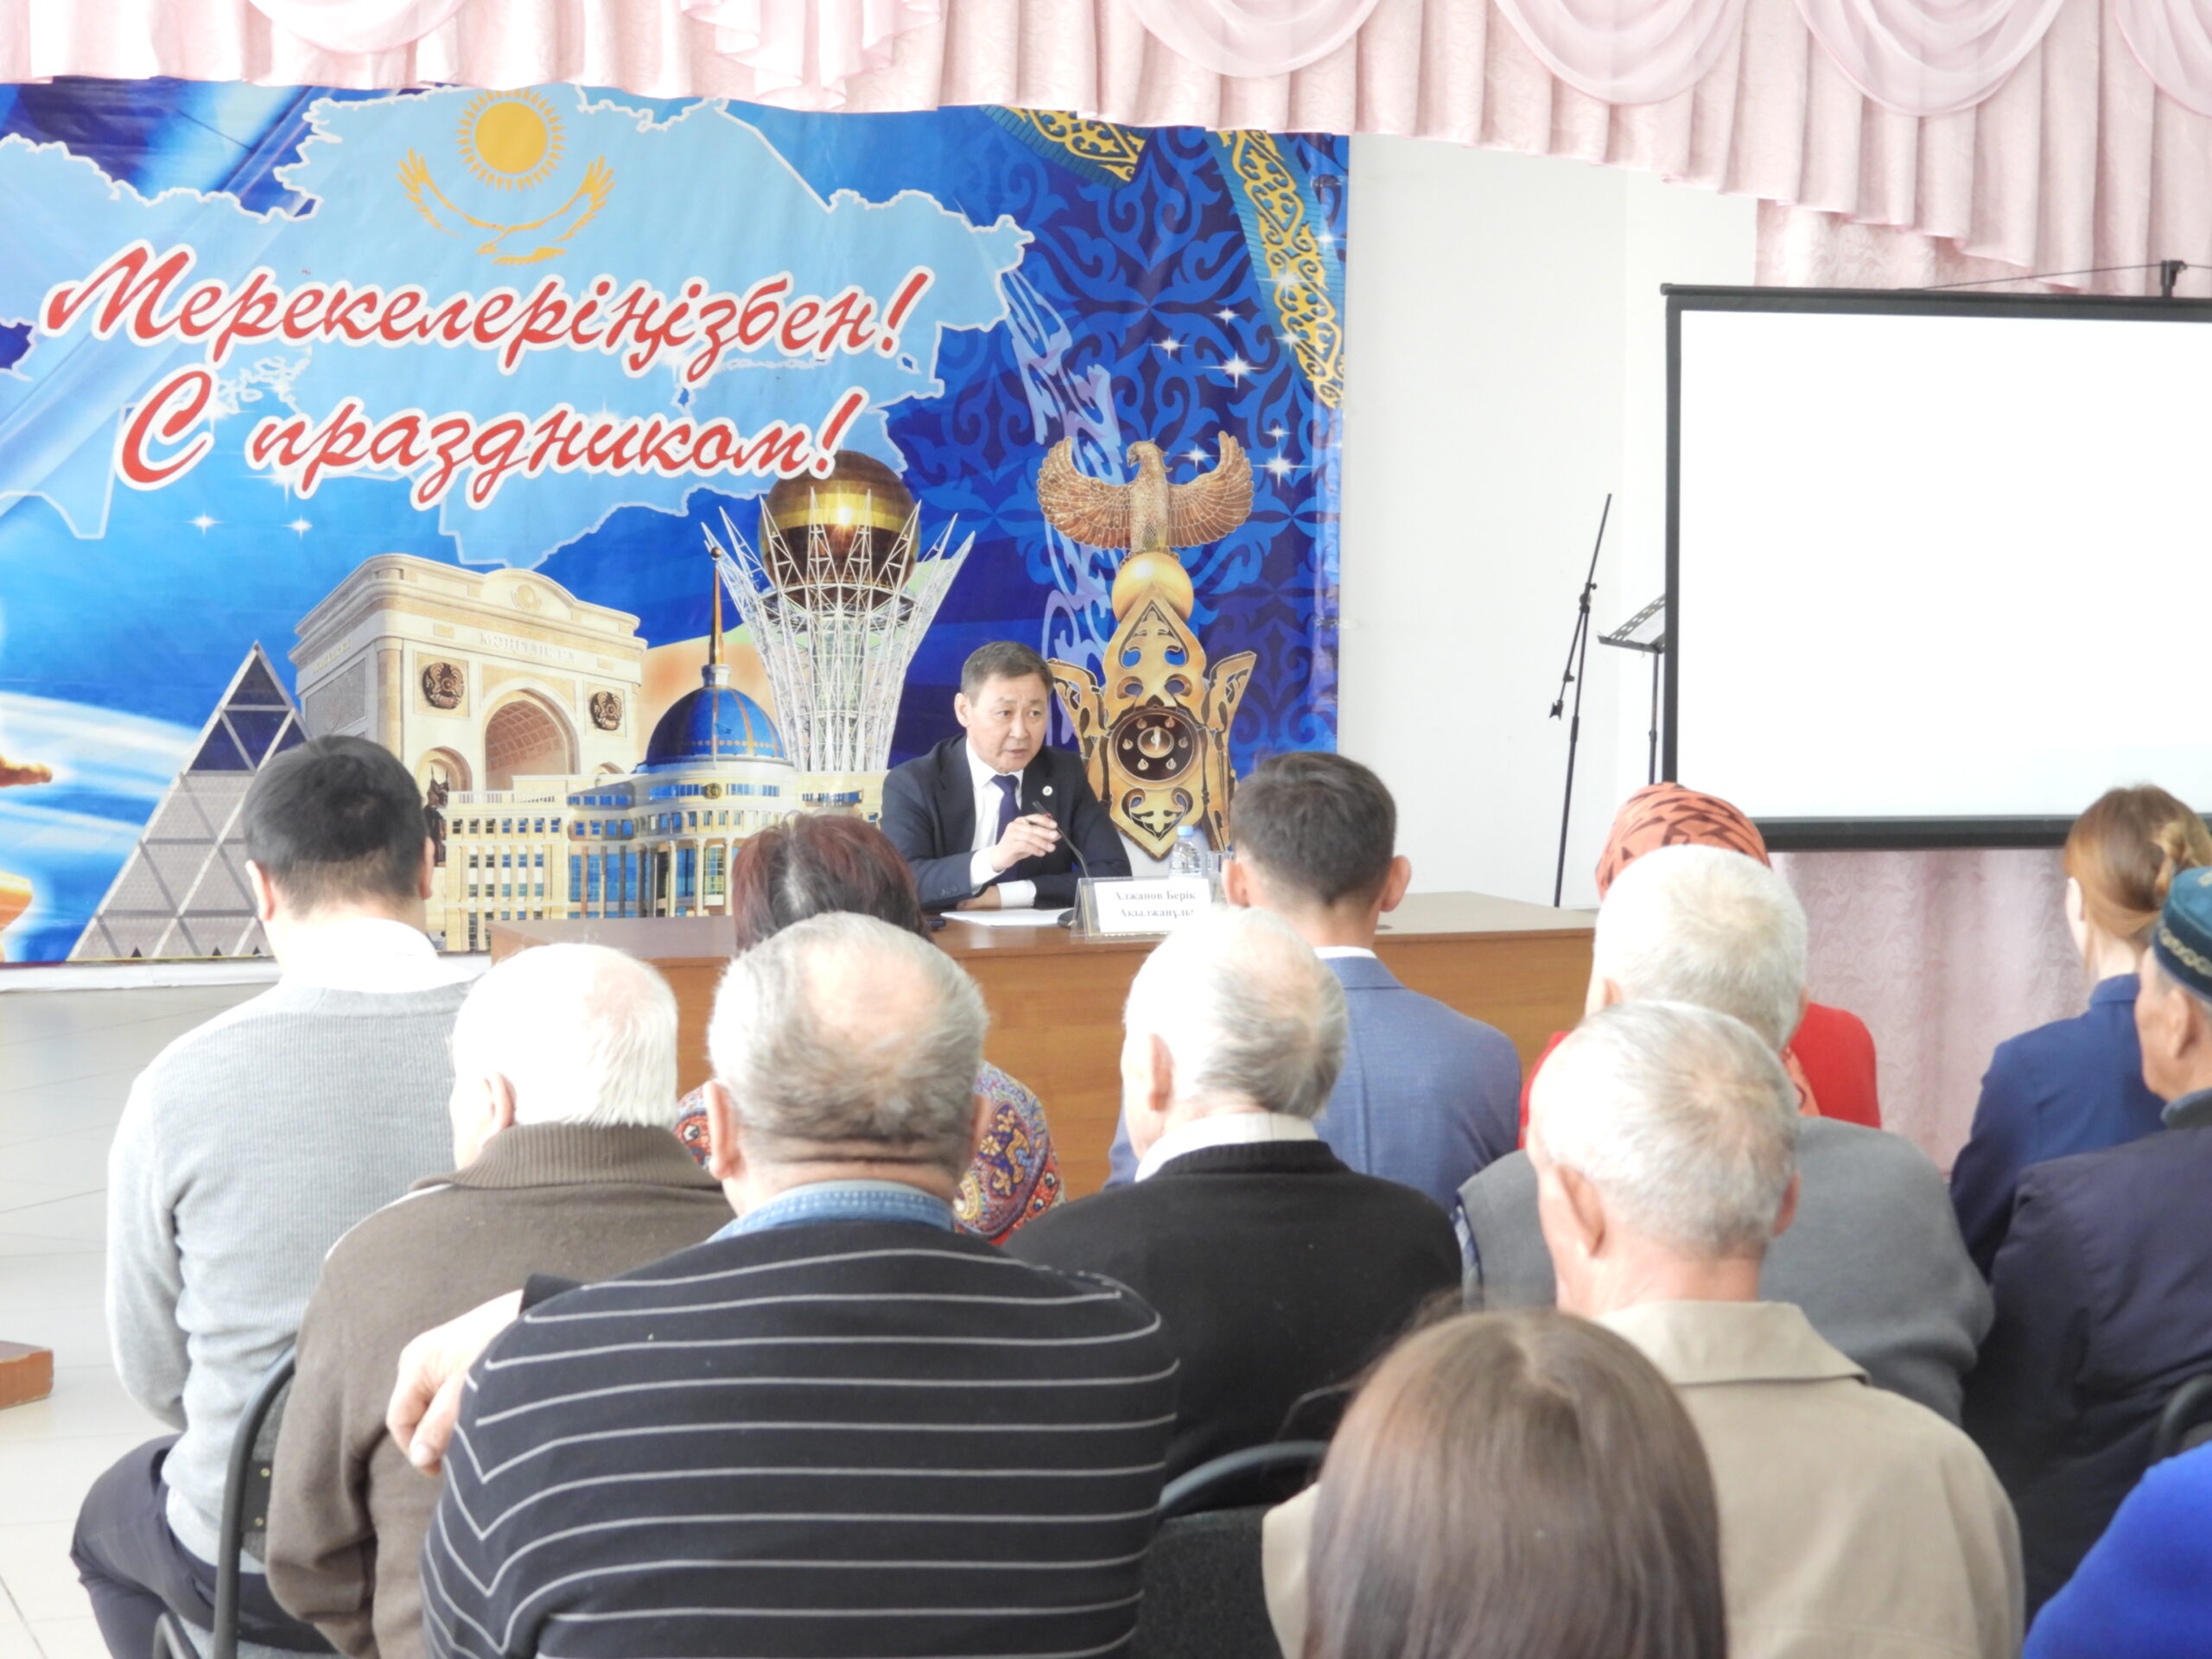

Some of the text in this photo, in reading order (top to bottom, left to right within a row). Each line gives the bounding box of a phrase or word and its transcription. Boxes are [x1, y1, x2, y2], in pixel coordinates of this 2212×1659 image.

[45, 245, 931, 383] Мерекелеріңізбен!
[120, 370, 865, 505] С праздником!
[1166, 889, 1196, 901] Берік
